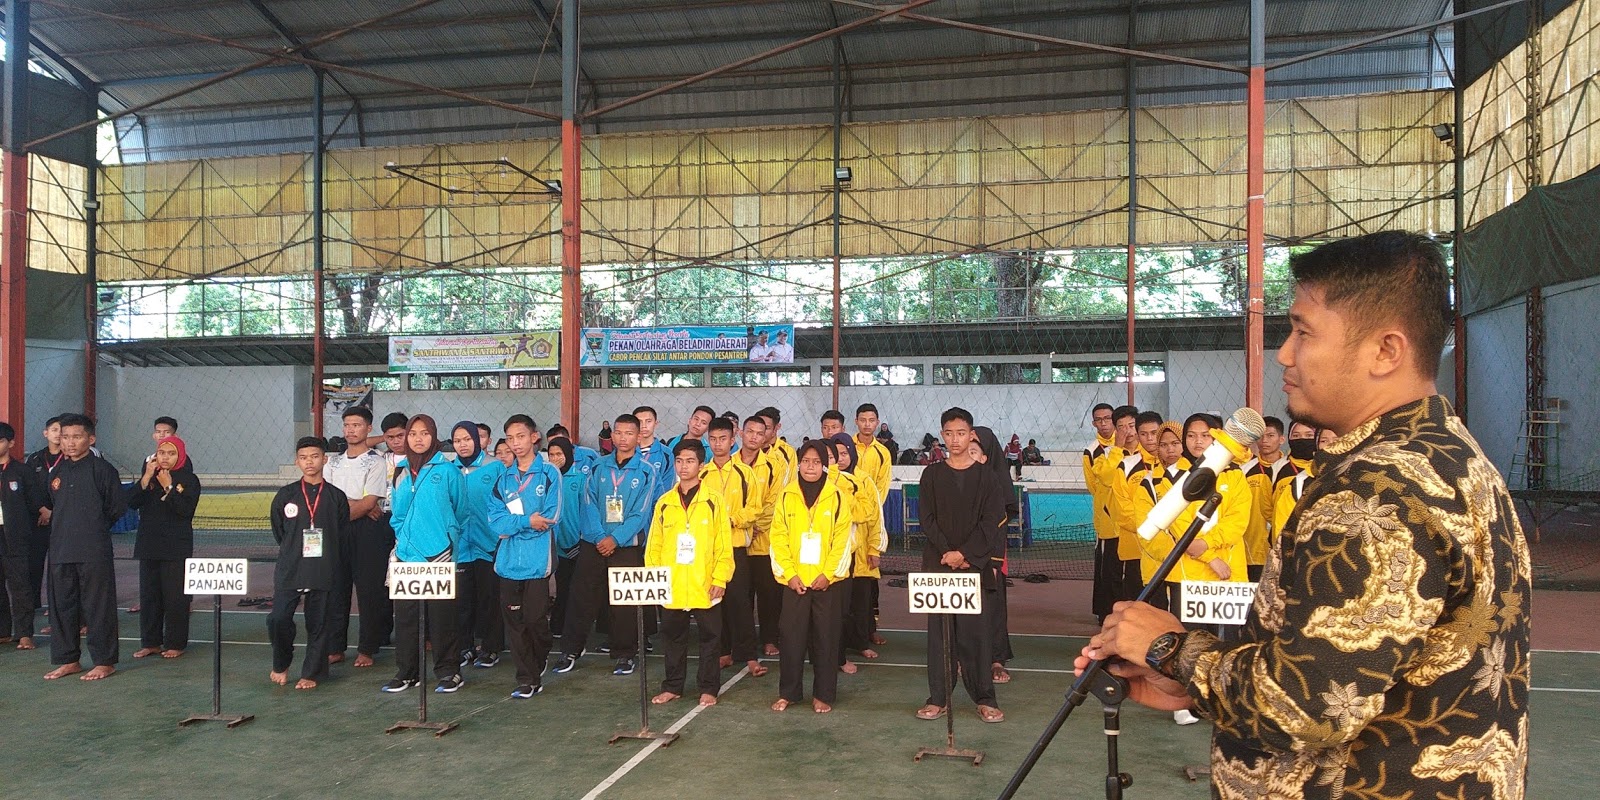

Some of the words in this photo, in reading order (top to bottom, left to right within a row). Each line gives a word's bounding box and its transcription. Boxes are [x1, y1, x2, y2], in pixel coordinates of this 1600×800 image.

[609, 340, 635, 351] PEKAN
[636, 339, 677, 351] OLAHRAGA
[678, 338, 713, 350] BELADIRI
[715, 338, 747, 349] DAERAH
[413, 348, 460, 357] SANTRIWAN
[461, 347, 468, 356] &
[469, 347, 516, 356] SANTRIWATI
[609, 353, 628, 361] CABOR
[629, 353, 651, 361] PENCAK
[652, 352, 667, 360] SILAT
[669, 352, 688, 360] ANTAR
[689, 351, 713, 360] PONDOK
[714, 350, 748, 359] PESANTREN
[189, 562, 243, 574] PADANG
[393, 566, 452, 575] KABUPATEN
[612, 570, 667, 583] TANAH
[912, 577, 976, 587] KABUPATEN
[188, 579, 243, 591] PANJANG
[394, 579, 451, 595] AGAM
[1186, 584, 1257, 597] KABUPATEN
[613, 588, 668, 601] DATAR
[913, 592, 976, 609] SOLOK
[1186, 600, 1206, 618] 50
